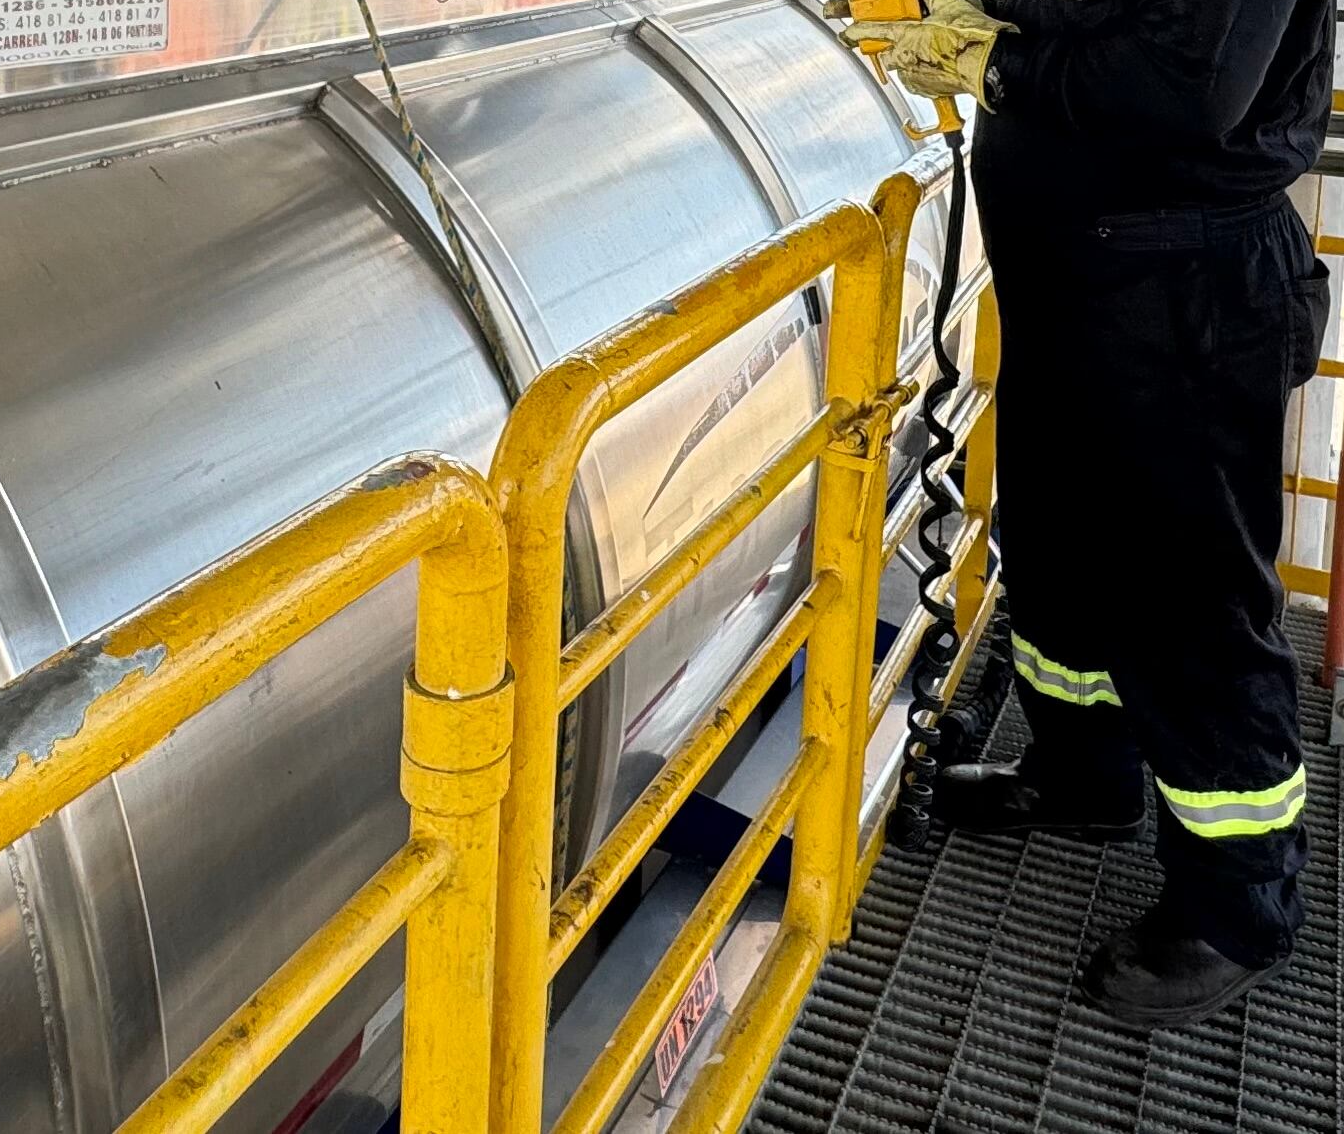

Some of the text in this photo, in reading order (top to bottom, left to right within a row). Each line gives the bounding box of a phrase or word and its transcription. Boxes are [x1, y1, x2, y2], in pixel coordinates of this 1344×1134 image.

[15, 15, 42, 29] 418
[47, 13, 62, 27] 81
[68, 11, 85, 25] 46
[98, 9, 121, 22] 418
[126, 8, 139, 21] 81
[145, 7, 160, 19] 47
